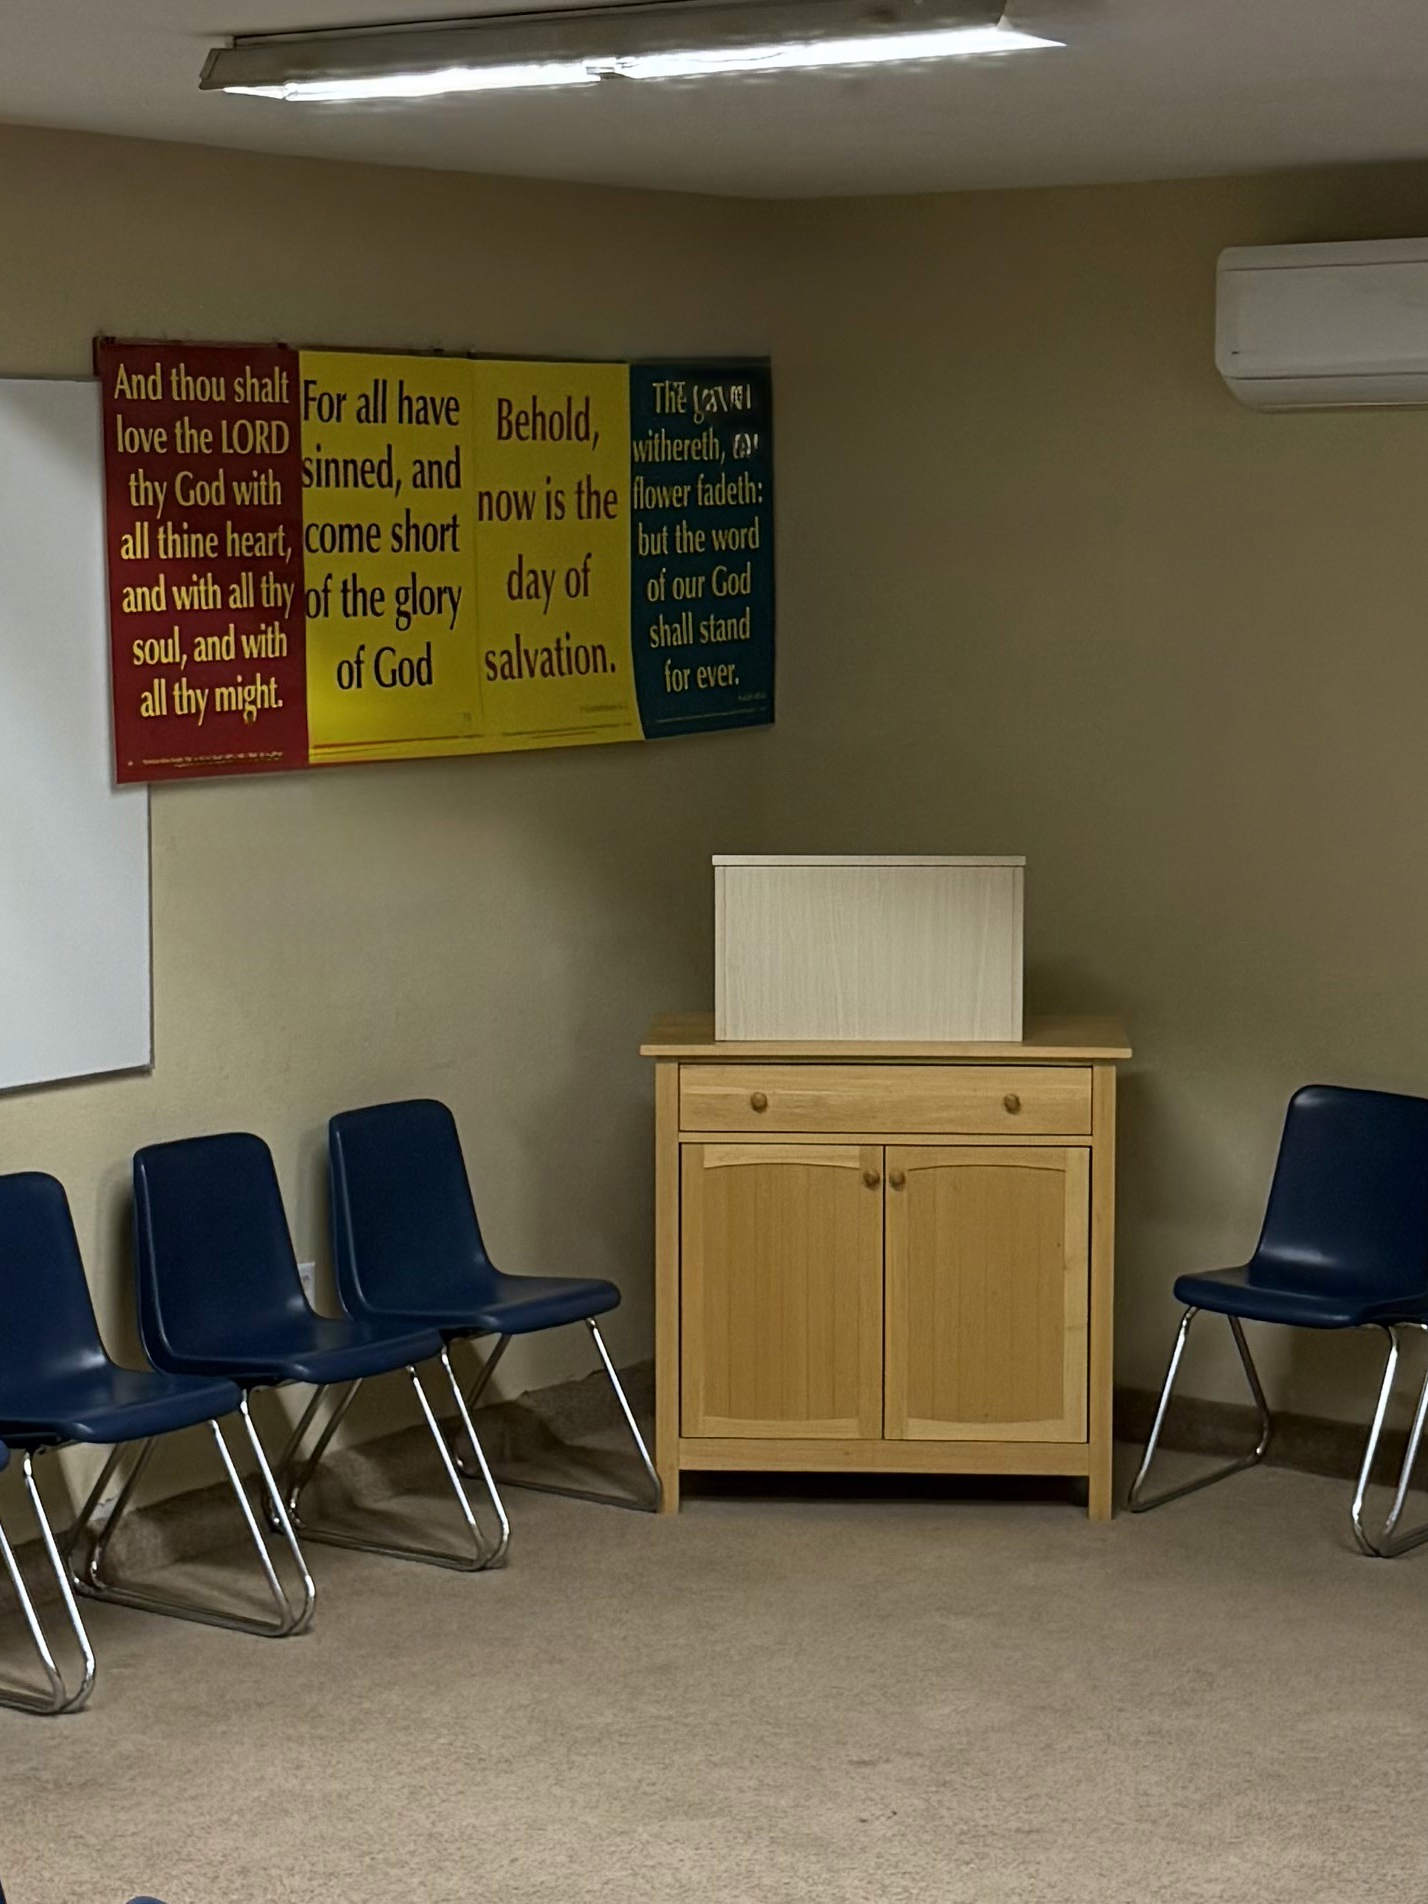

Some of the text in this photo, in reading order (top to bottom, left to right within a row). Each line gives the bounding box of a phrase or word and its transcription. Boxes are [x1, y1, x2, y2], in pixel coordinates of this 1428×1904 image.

[114, 362, 290, 403] And thou shalt
[303, 378, 460, 426] For all have
[653, 380, 687, 414] The
[117, 414, 289, 454] love the LORD
[497, 395, 599, 451] Behold,
[633, 426, 725, 464] withereth,
[129, 468, 281, 519] thy God with
[302, 443, 461, 498] sinned, and
[633, 471, 763, 510] flower fadeth:
[478, 474, 618, 522] now is the
[120, 520, 292, 564] all thine heart,
[305, 508, 460, 554] come short
[638, 516, 759, 556] but the word
[122, 571, 295, 619] and with all thy
[305, 571, 462, 631] of the glory
[507, 552, 592, 615] day of
[647, 561, 751, 602] of our God
[132, 621, 287, 671] soul, and with
[650, 606, 750, 648] shall stand
[337, 641, 433, 690] of God
[485, 631, 616, 681] salvation.
[665, 659, 739, 693] for ever.
[140, 672, 283, 726] all thy might.
